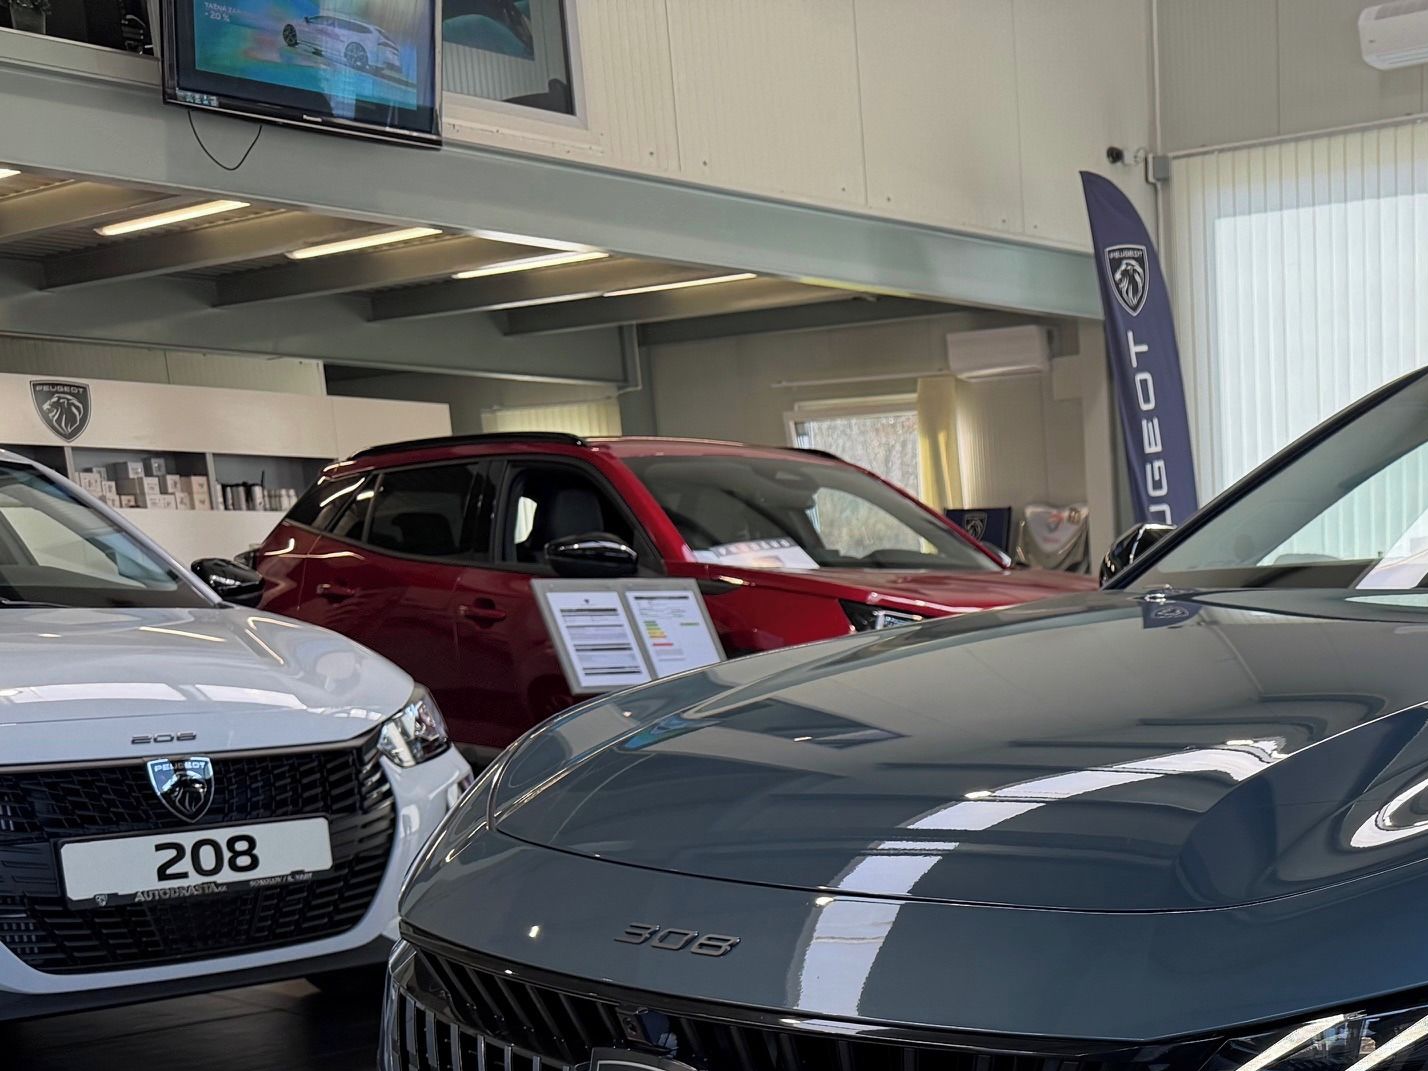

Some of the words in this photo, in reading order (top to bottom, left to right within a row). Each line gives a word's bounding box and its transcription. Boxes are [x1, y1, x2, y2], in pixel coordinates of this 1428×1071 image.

[36, 385, 84, 393] PEUGEOT
[1127, 330, 1173, 525] UGEOT
[131, 731, 197, 745] 208
[154, 834, 260, 882] 208
[613, 922, 742, 958] 308
